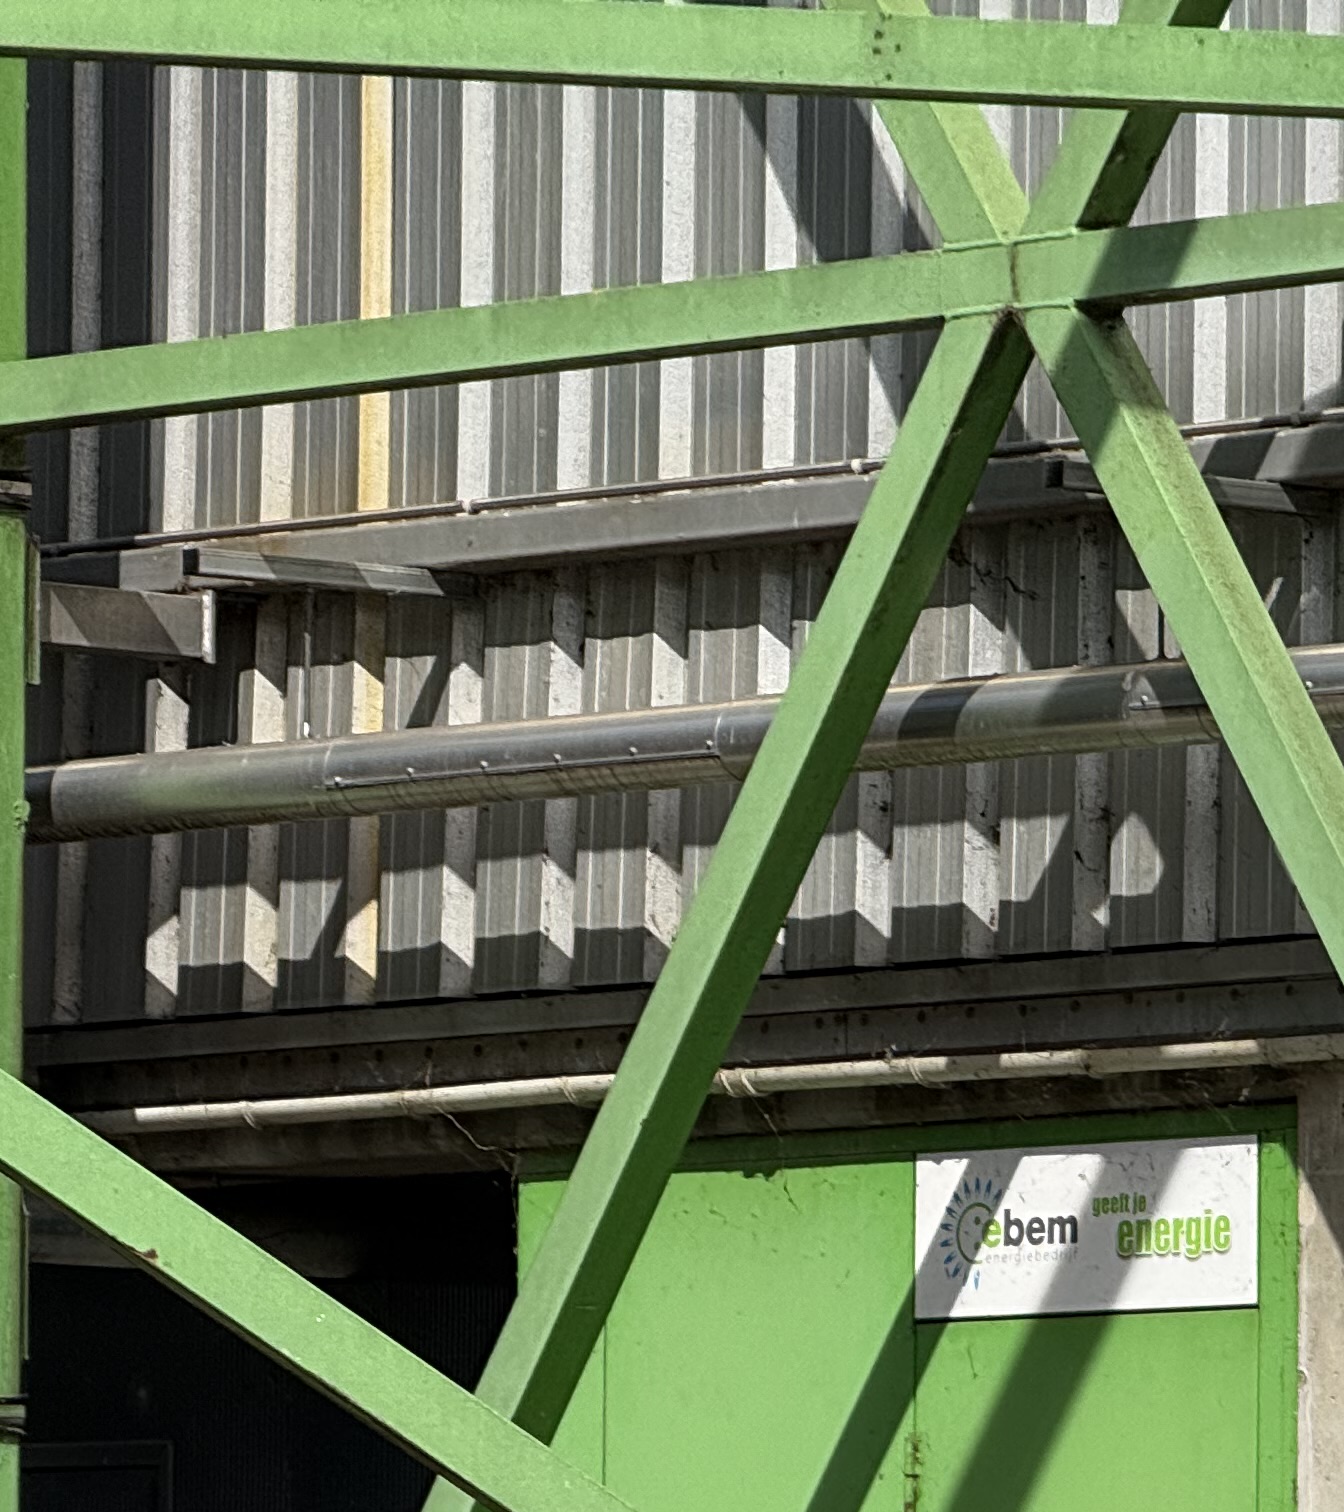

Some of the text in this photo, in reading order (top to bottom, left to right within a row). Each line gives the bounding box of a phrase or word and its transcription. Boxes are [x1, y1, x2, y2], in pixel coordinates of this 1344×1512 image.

[1092, 1192, 1146, 1217] geeft je
[982, 1208, 1078, 1248] ebem
[1117, 1209, 1231, 1256] energie
